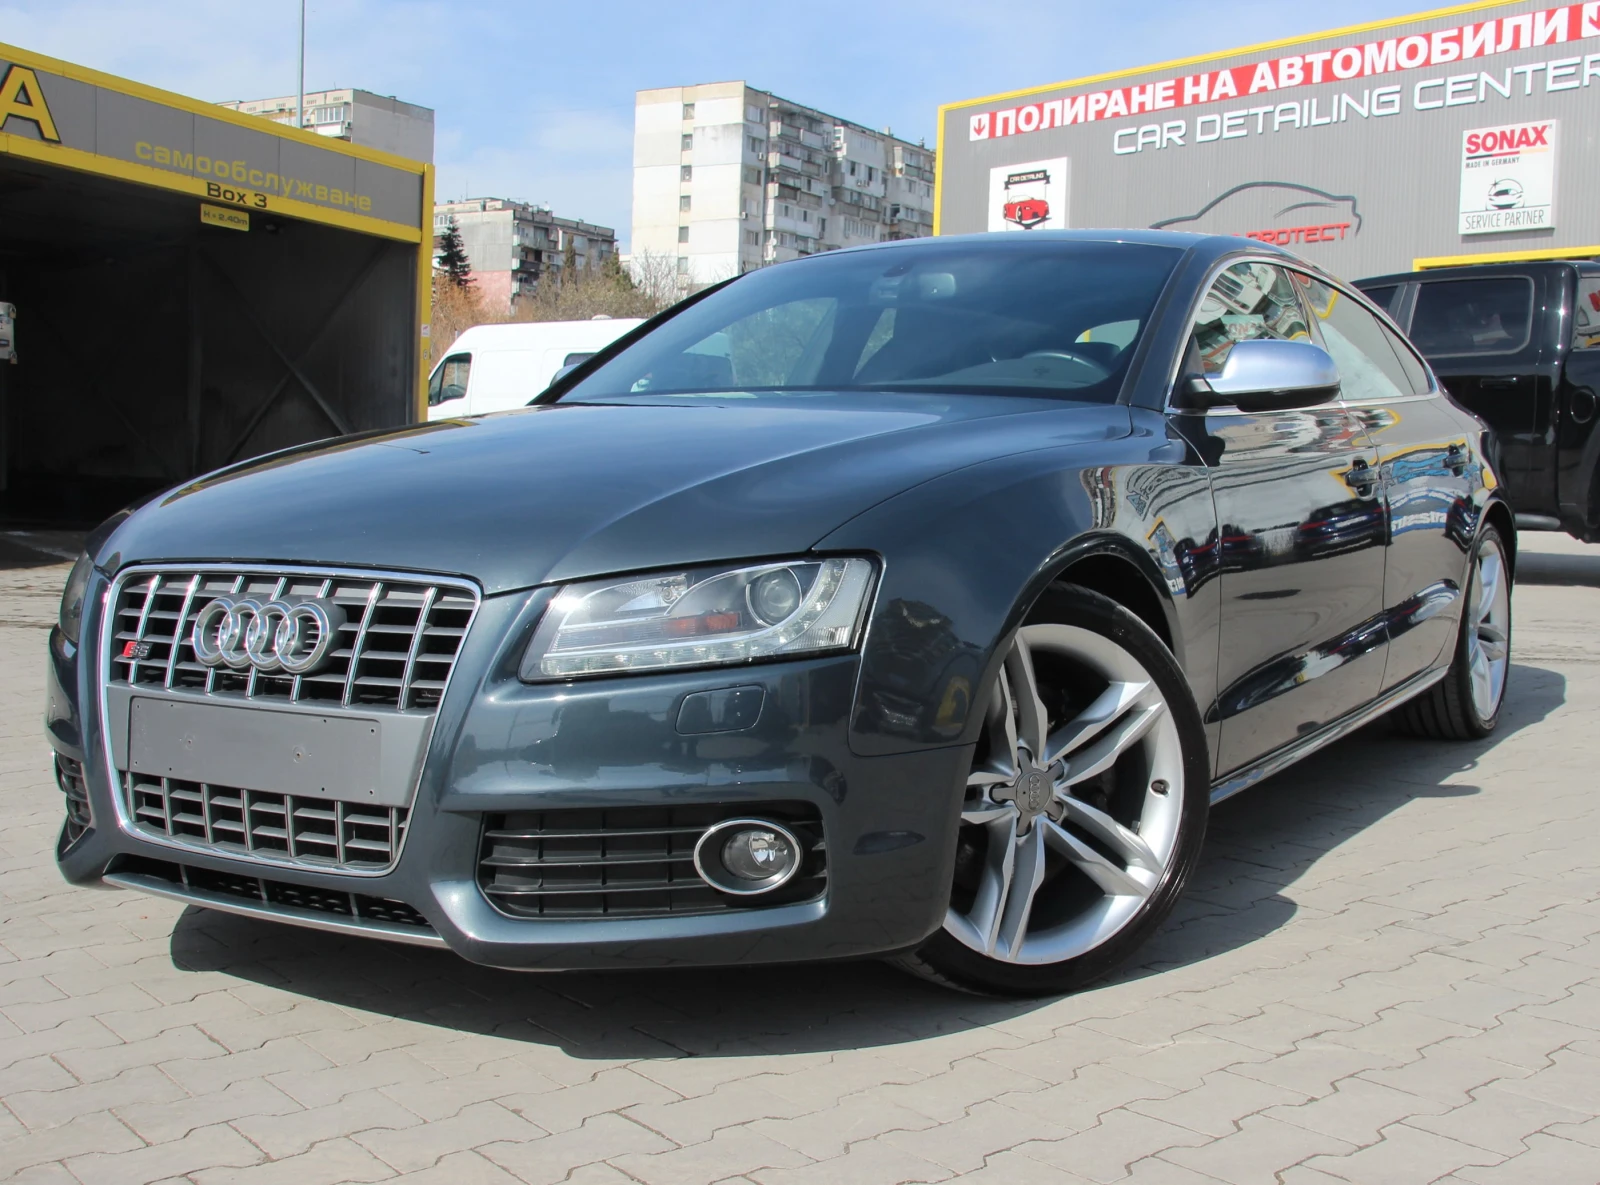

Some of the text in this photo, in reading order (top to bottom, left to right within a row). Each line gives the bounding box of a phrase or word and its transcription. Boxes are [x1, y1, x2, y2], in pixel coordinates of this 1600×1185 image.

[995, 7, 1569, 137] ПОЛИРАНЕ НА АВТОМОБИЛИ
[1113, 119, 1186, 155] CAR
[1196, 85, 1401, 143] DETAILING
[1465, 125, 1548, 154] SONAX
[135, 141, 372, 212] самообслужване
[1465, 160, 1481, 168] MADE
[1492, 157, 1520, 166] GERMANY
[206, 181, 267, 209] Box 3
[1465, 209, 1545, 230] SERVICE PARTNER
